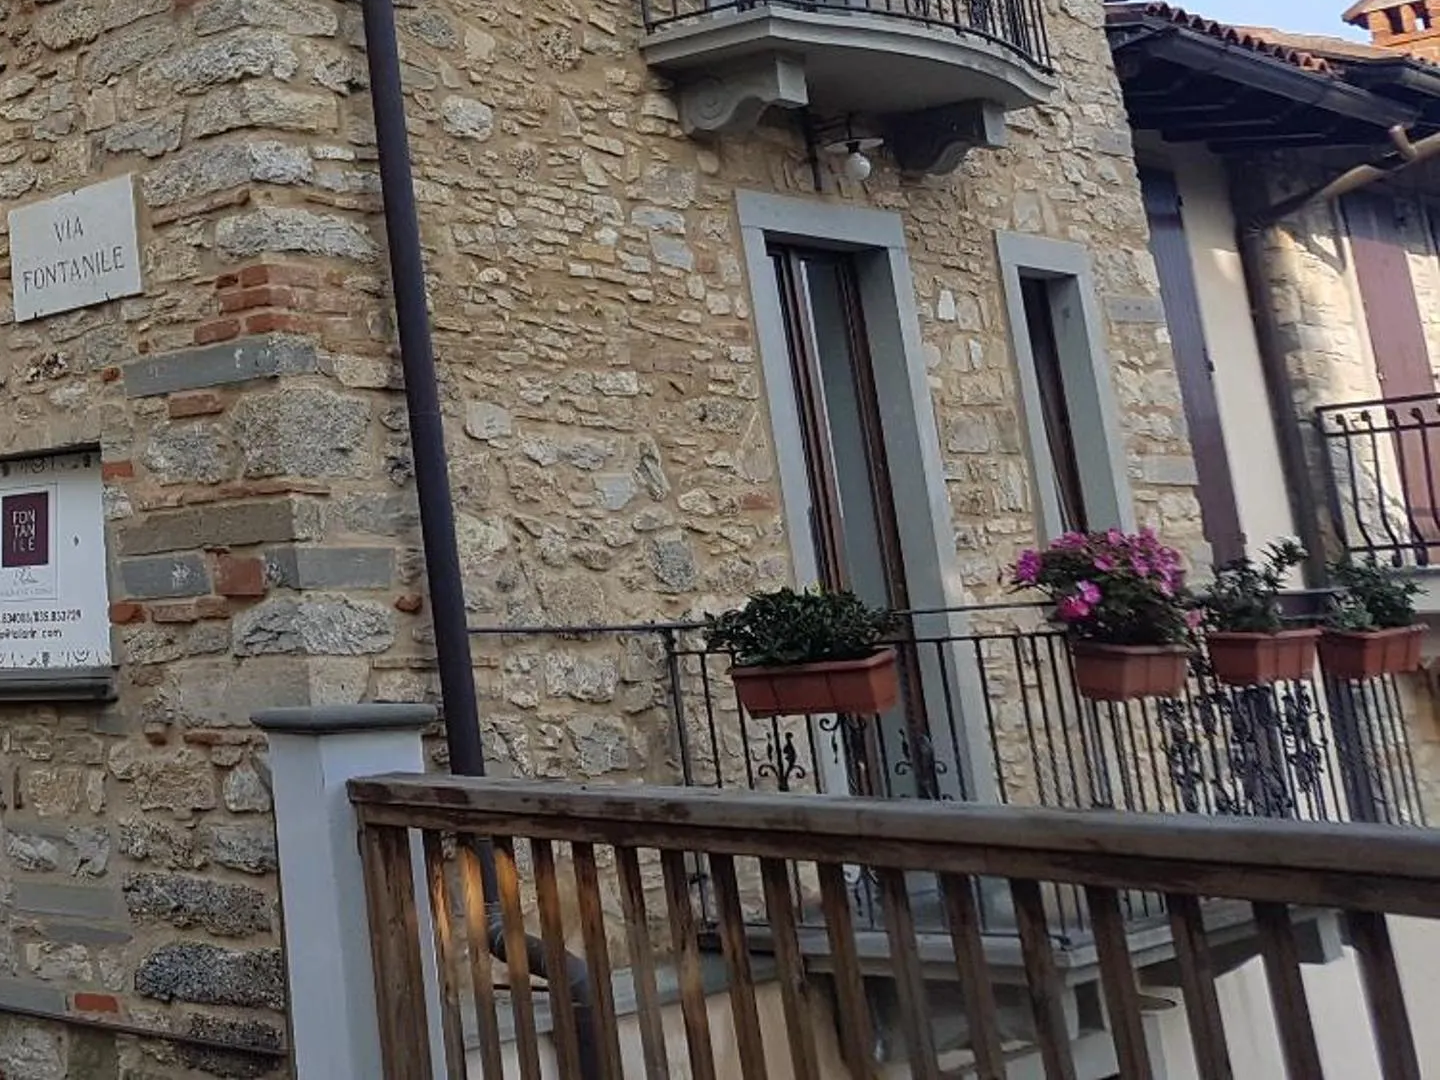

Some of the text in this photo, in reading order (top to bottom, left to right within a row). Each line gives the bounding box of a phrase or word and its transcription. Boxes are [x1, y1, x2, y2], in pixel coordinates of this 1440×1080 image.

[52, 216, 84, 242] VIA
[22, 245, 126, 294] FONTANILE
[12, 508, 36, 524] FON
[13, 523, 36, 538] TAN
